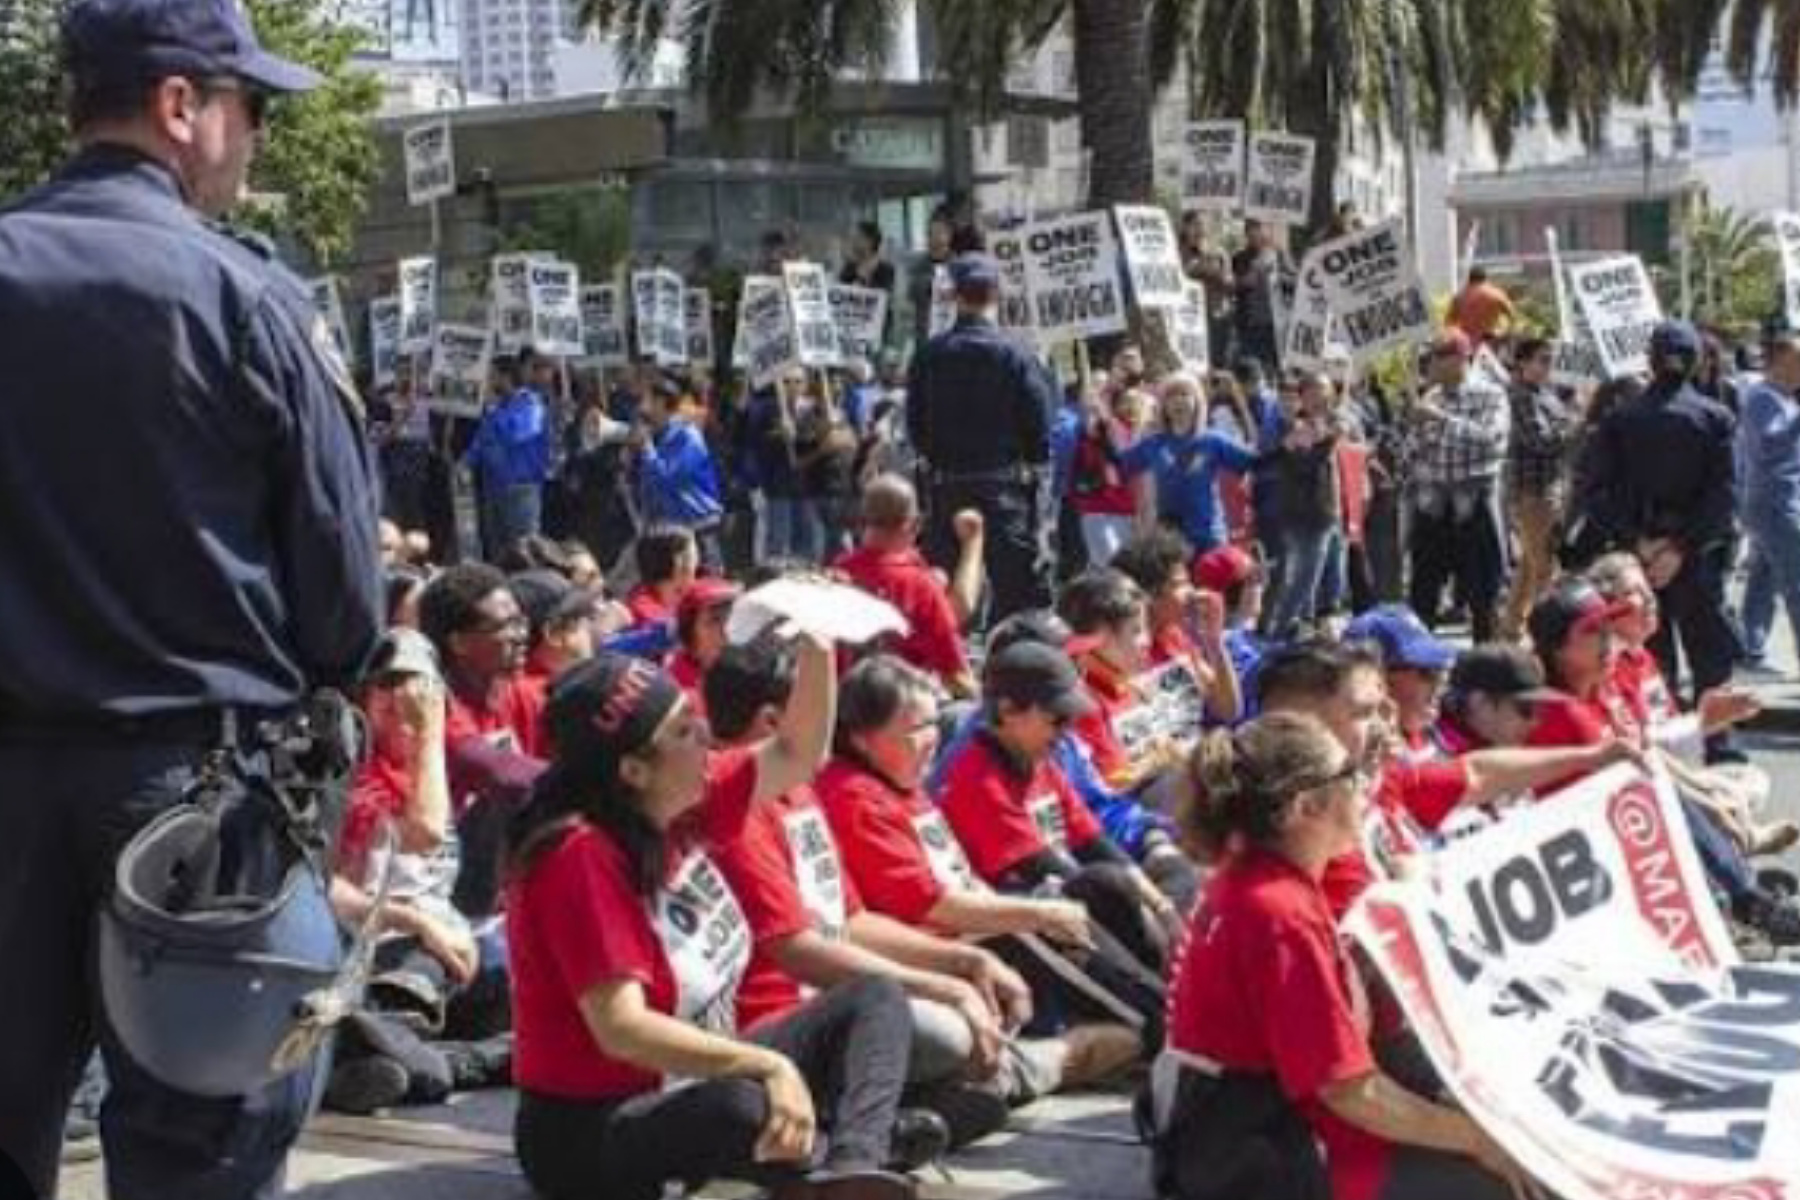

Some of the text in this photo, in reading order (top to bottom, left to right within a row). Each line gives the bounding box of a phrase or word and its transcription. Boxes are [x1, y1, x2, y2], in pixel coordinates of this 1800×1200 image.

[1028, 222, 1100, 254] ONE
[1324, 230, 1397, 276] ONE
[1039, 246, 1098, 270] JOB
[1340, 256, 1398, 288] JOB
[1581, 264, 1641, 292] ONE
[667, 859, 724, 937] ONE
[1465, 828, 1613, 958] JOB
